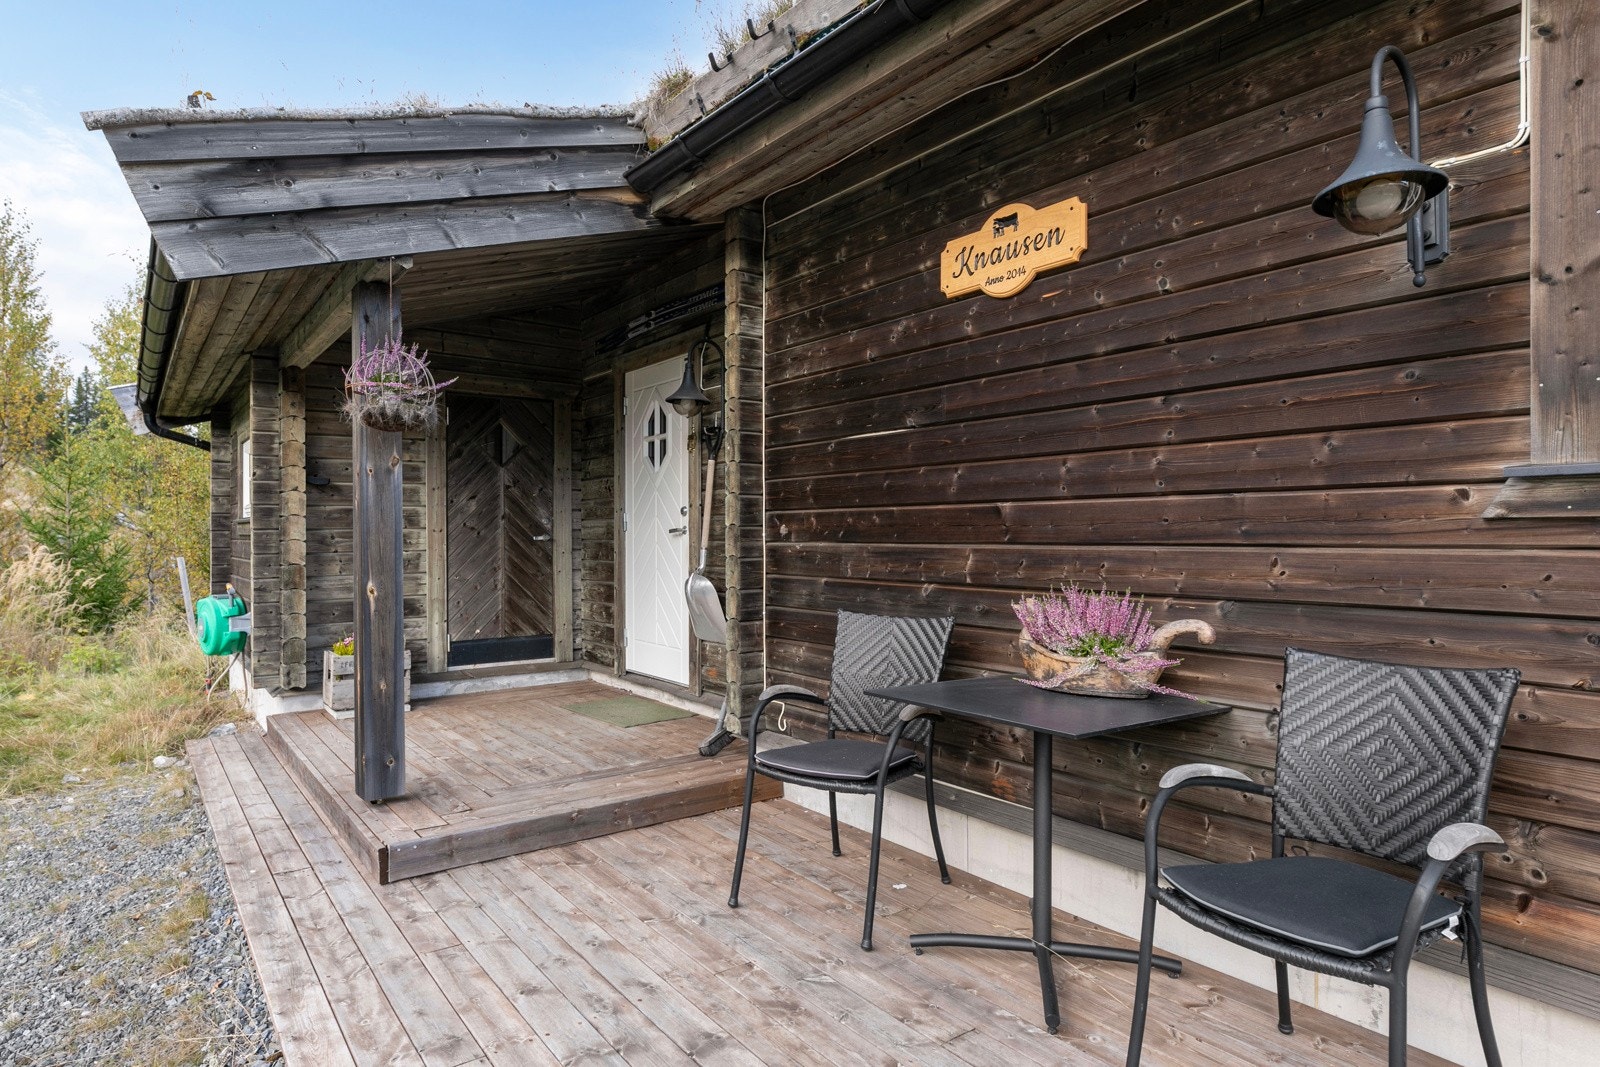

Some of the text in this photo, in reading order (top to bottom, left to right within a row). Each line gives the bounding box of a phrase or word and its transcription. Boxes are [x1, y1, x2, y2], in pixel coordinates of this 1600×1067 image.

[952, 227, 1066, 279] Knausen
[984, 265, 1027, 287] Anno 2014
[687, 286, 719, 304] ATOMIC
